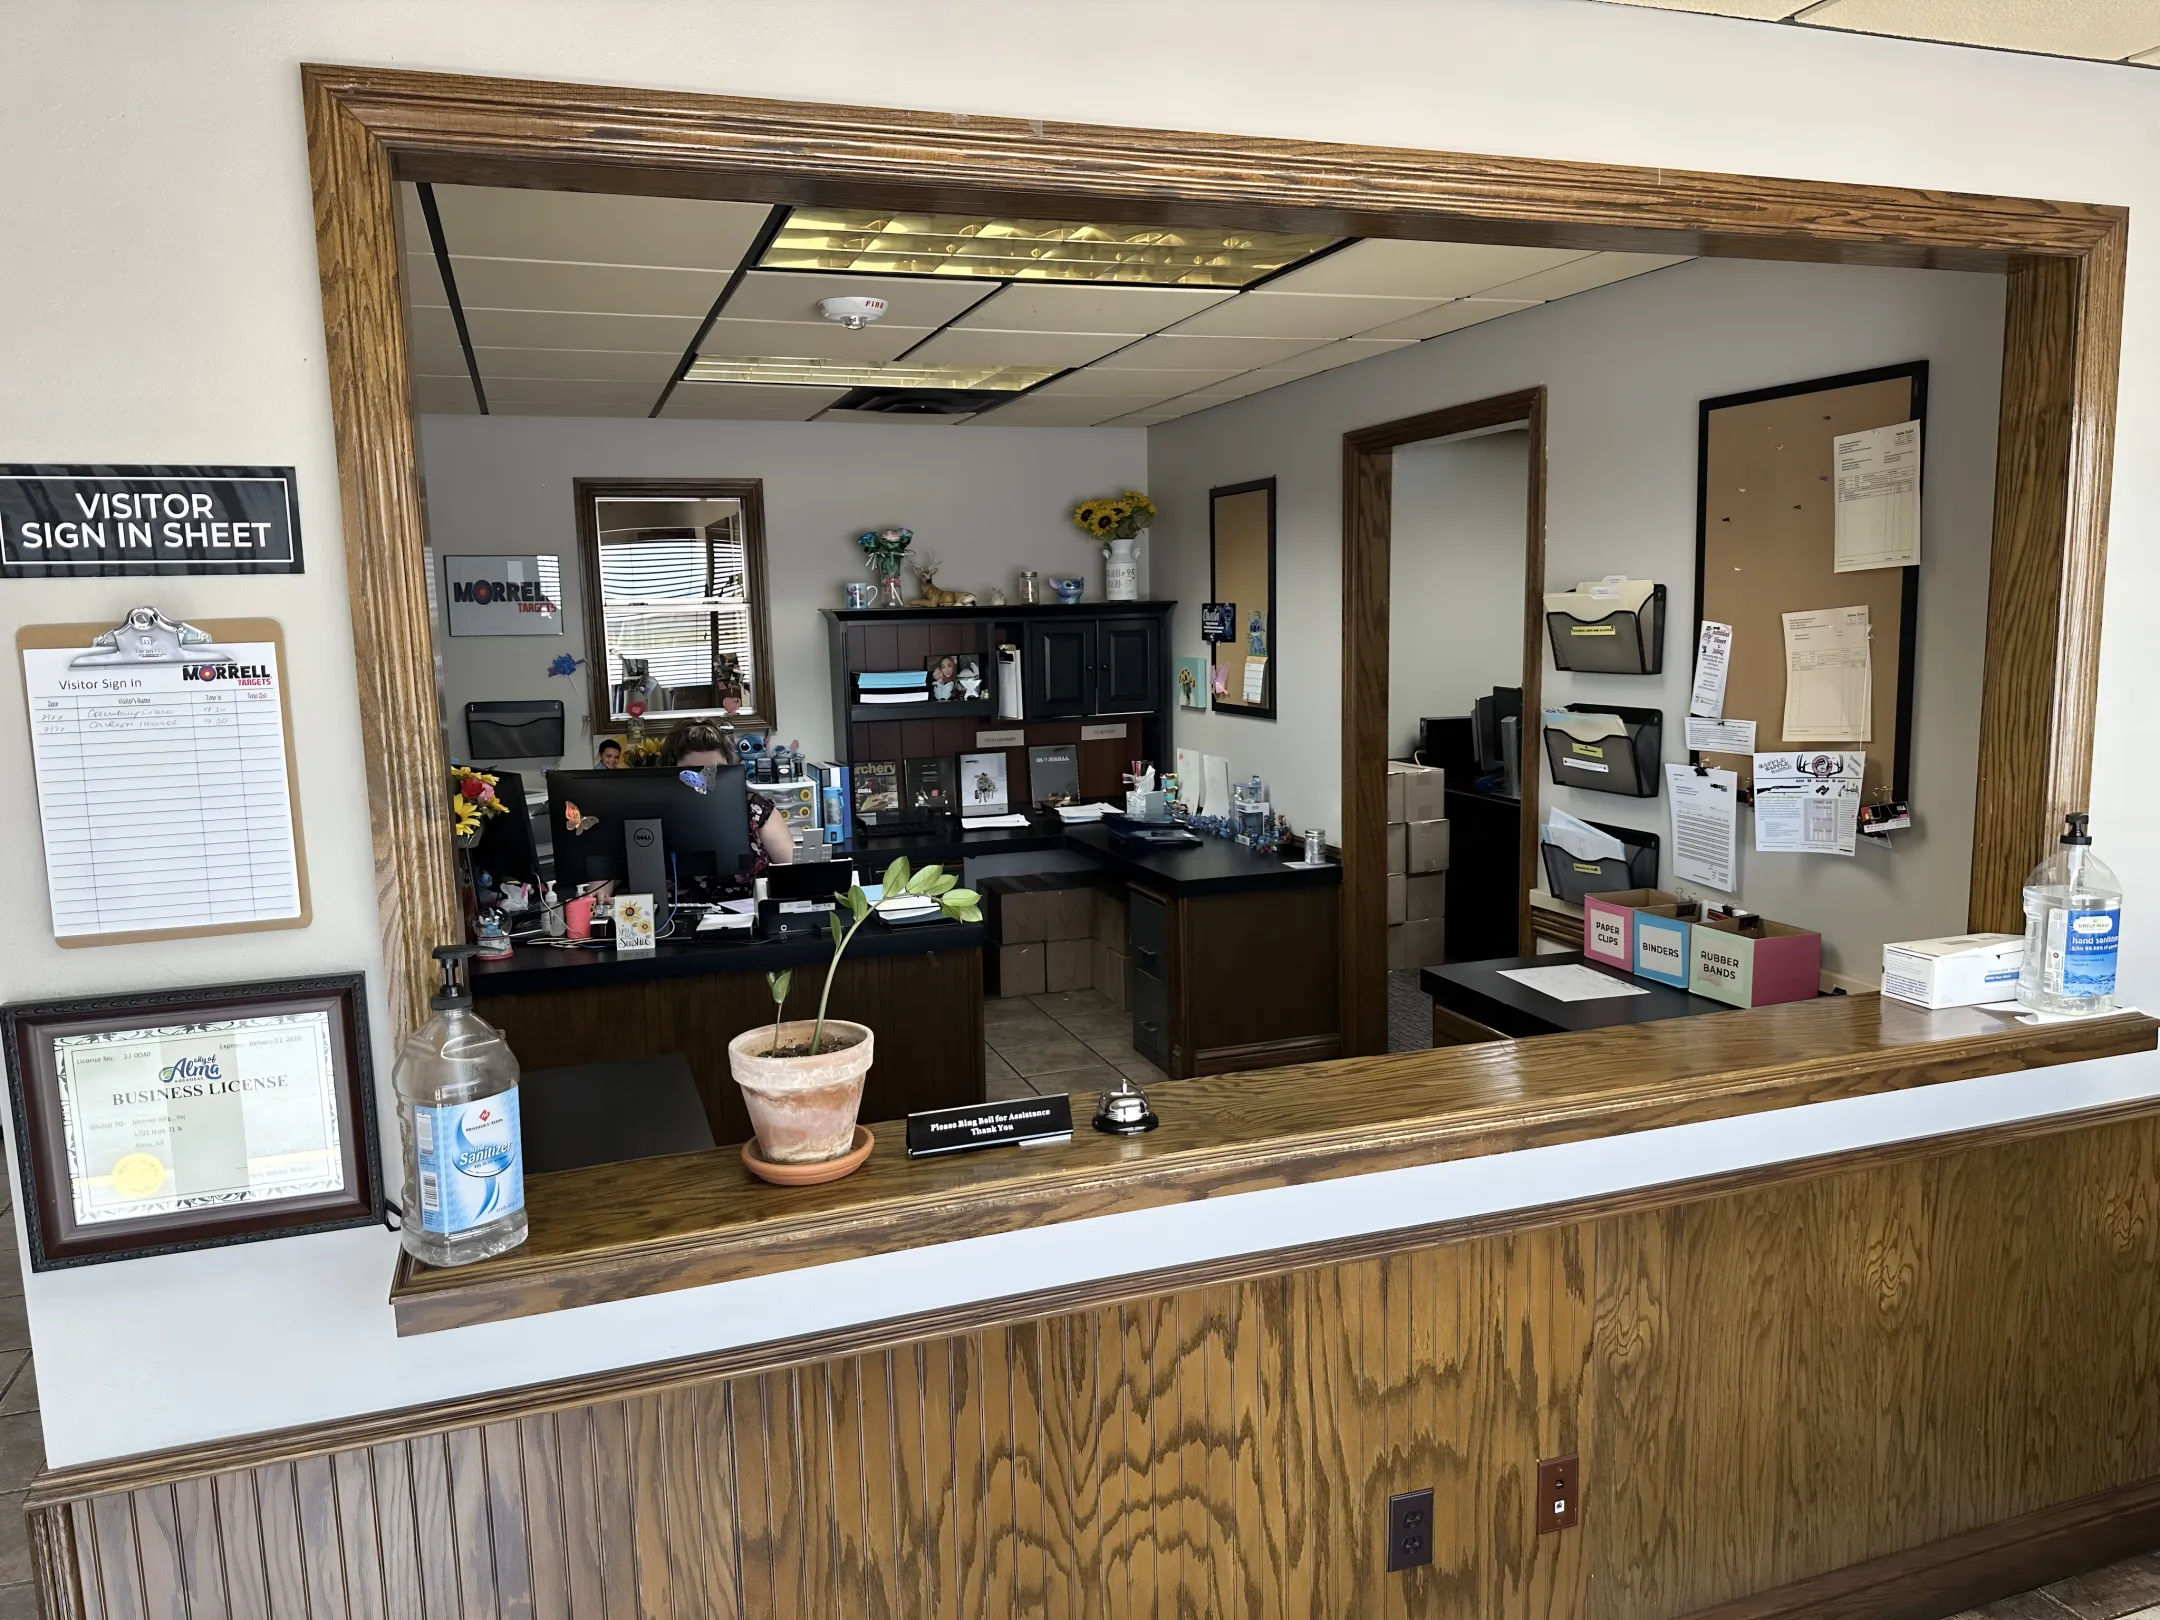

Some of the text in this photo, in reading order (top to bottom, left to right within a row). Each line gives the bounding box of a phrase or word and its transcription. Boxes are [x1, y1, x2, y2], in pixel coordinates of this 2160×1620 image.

[75, 492, 214, 519] VISITOR
[21, 522, 272, 549] SIGN IN SHEET
[182, 663, 272, 682] MORRELL
[58, 678, 142, 691] Visitor Sign In
[237, 677, 272, 687] TARGETS
[854, 763, 896, 776] rchery
[1596, 921, 1620, 936] PAPER
[1597, 933, 1619, 947] CLIPS
[2072, 936, 2094, 945] hand
[1642, 942, 1680, 959] BINDERS
[1700, 950, 1740, 969] RUBBER
[1703, 963, 1736, 980] BANDS
[194, 1054, 217, 1065] city of
[159, 1057, 222, 1083] Alma
[209, 1074, 289, 1095] LICENSE
[112, 1084, 203, 1106] BUSINESS
[930, 1109, 1051, 1132] Please Ring Bell for Assistance
[970, 1123, 1014, 1136] Thank You
[459, 1141, 514, 1166] Sanitizer
